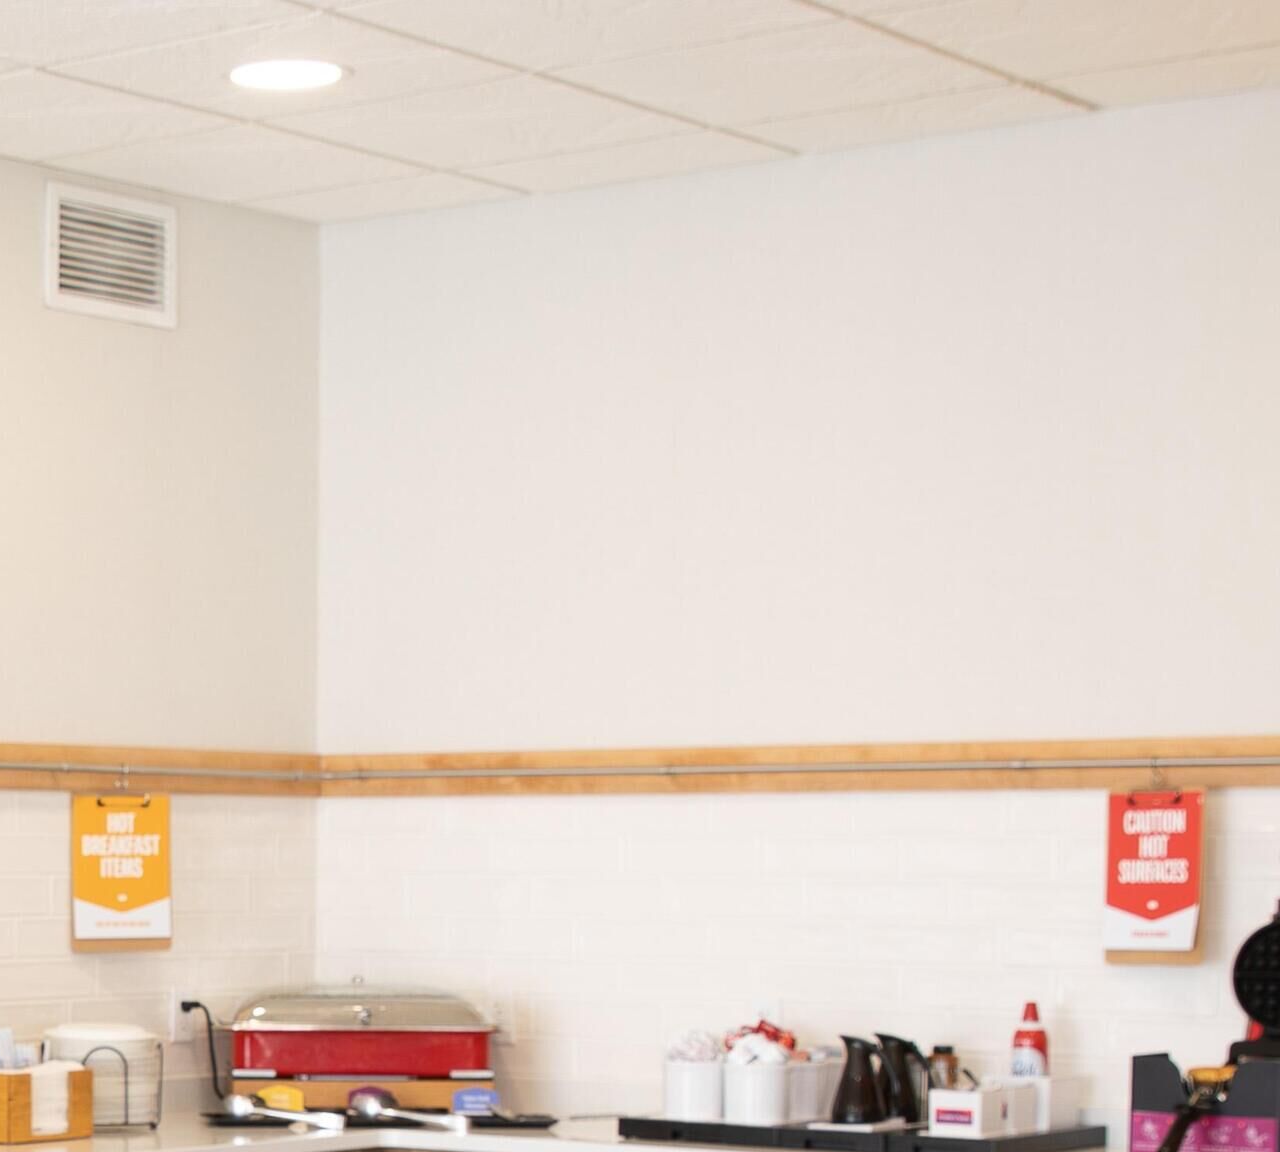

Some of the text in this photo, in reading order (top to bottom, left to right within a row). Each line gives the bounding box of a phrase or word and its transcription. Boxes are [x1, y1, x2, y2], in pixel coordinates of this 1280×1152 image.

[106, 811, 136, 834] HOT
[1123, 809, 1187, 835] CAUTION
[81, 834, 160, 857] BREAKFAST
[1138, 834, 1170, 858] HOT
[100, 856, 144, 879] ITEMS
[1118, 858, 1189, 884] SURFACES
